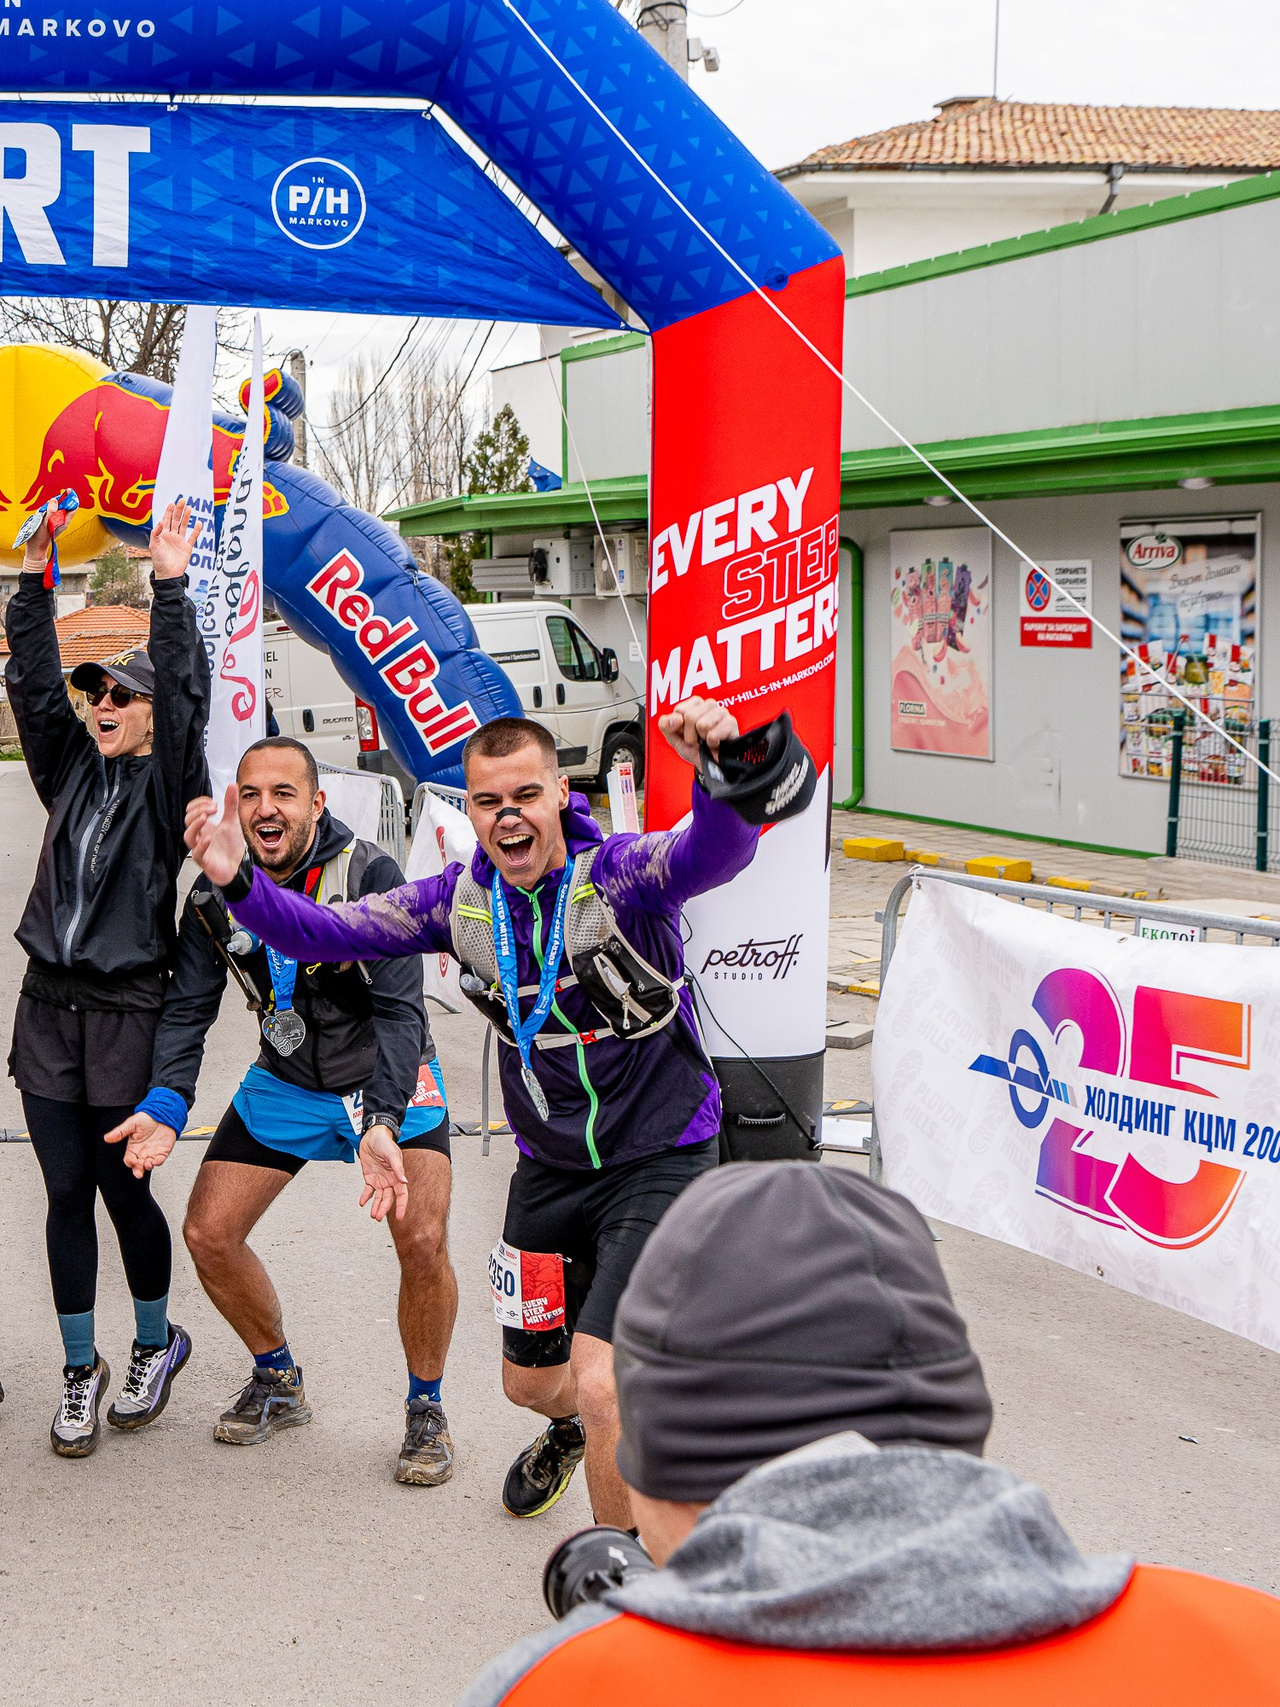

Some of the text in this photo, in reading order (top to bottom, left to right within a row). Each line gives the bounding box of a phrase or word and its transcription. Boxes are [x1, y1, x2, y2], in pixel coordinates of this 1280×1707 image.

[311, 176, 325, 184] IN
[289, 217, 349, 228] MARKOVO
[651, 466, 815, 595] EVERY
[1131, 543, 1177, 560] Arriva
[722, 513, 839, 621] STEP
[308, 550, 480, 753] Red Bull
[322, 716, 354, 725] DUCATO
[713, 971, 763, 981] STUDIO
[1084, 1084, 1176, 1137] ХОЛДИНГ
[1183, 1107, 1237, 1154] КЦМ
[521, 1296, 549, 1310] EVERY
[522, 1306, 546, 1318] STEP
